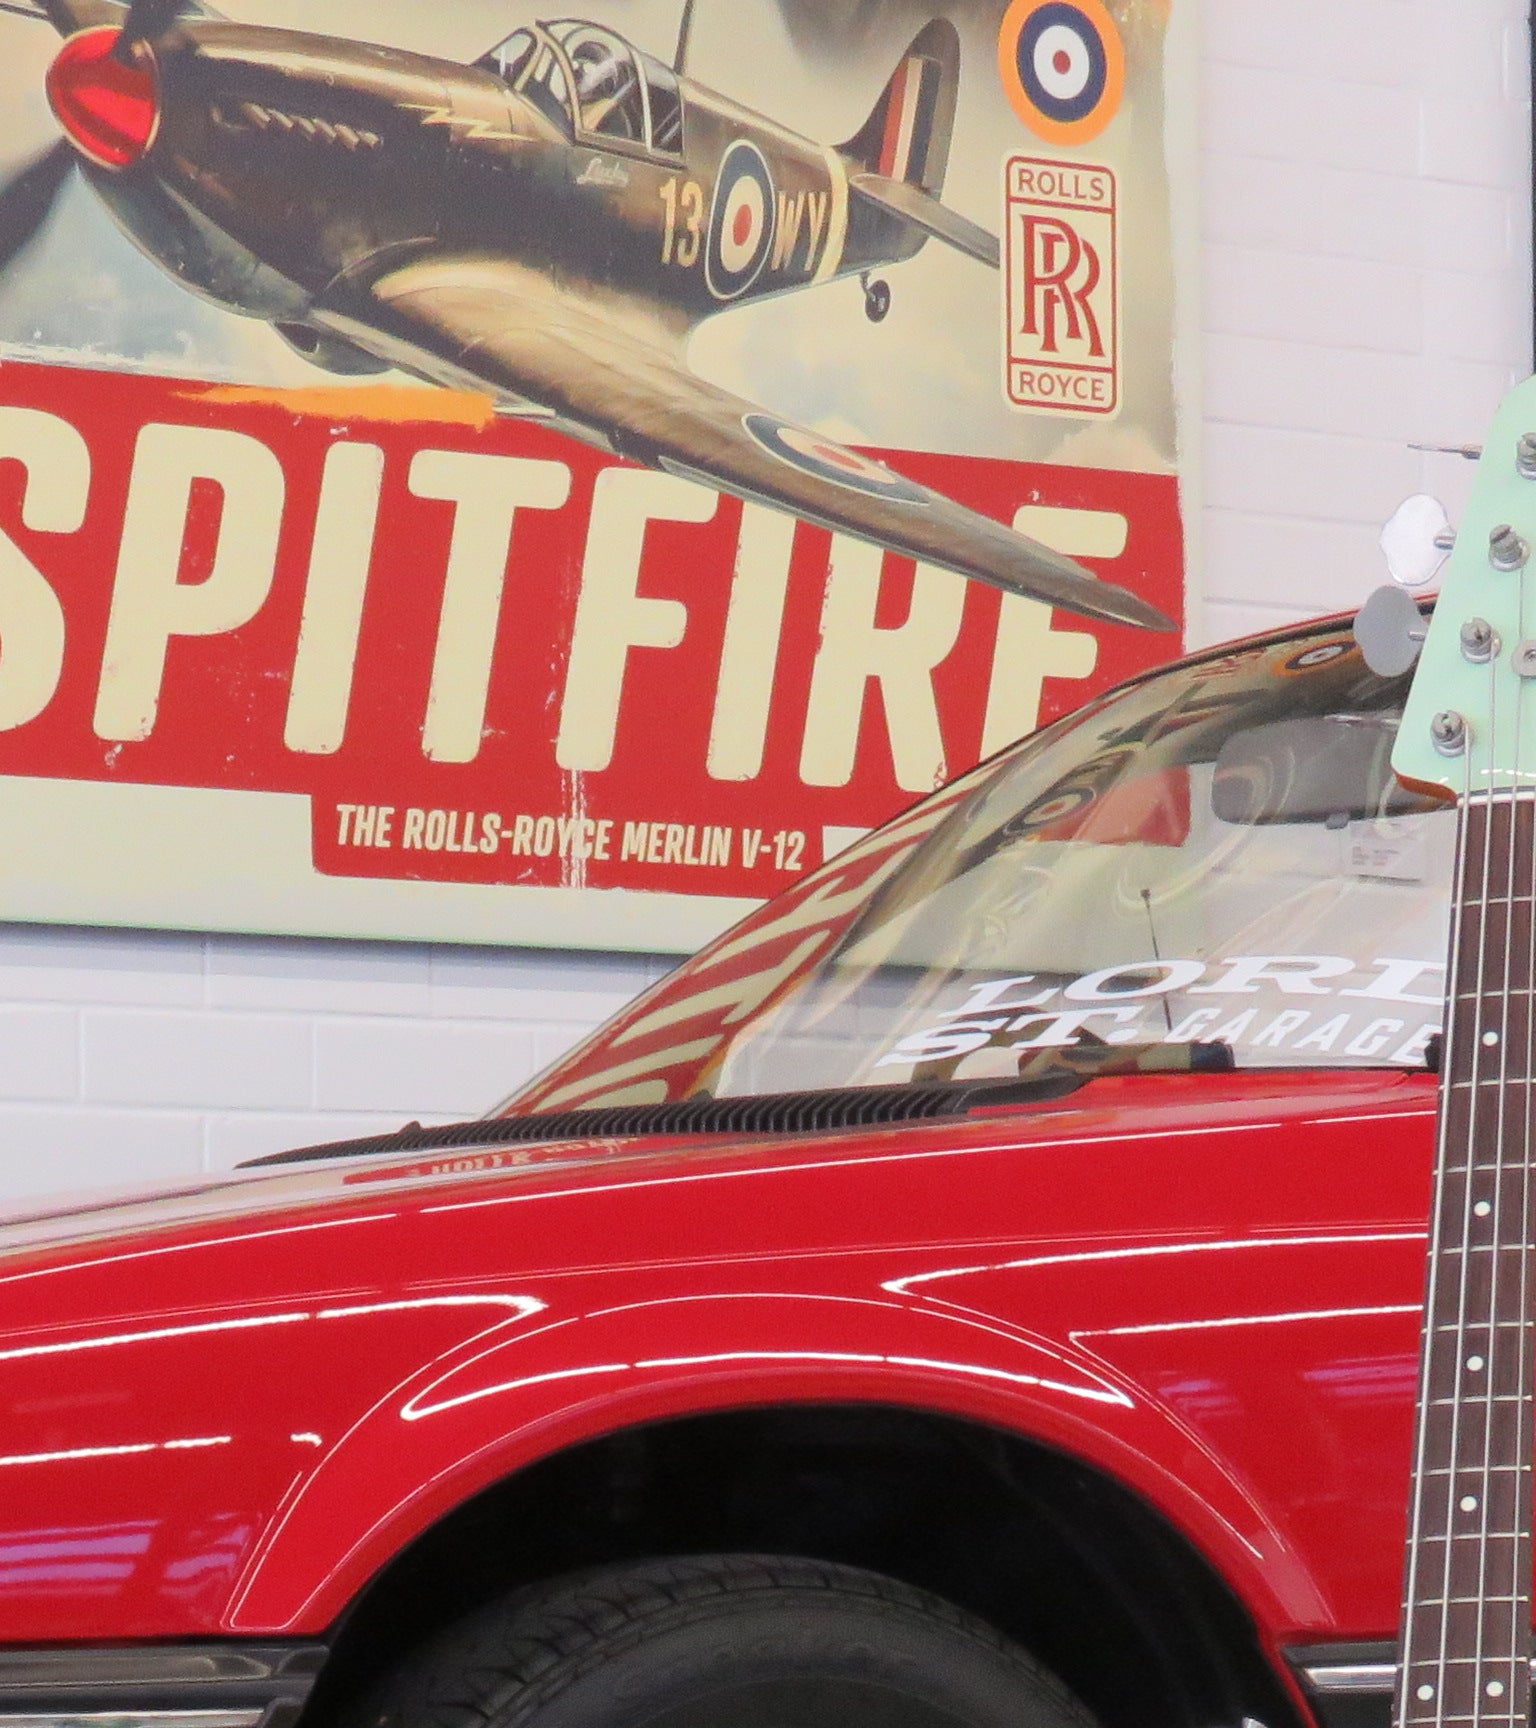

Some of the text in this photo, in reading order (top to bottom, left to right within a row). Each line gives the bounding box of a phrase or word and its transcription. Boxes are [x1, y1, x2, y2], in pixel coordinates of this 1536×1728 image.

[1017, 167, 1106, 202] ROLLS
[659, 175, 827, 272] 13 WY
[1018, 370, 1106, 402] ROYCE
[336, 803, 806, 871] THE ROLLS-ROYCE MERLIN V-12
[875, 1005, 1443, 1067] ST. GARAGE
